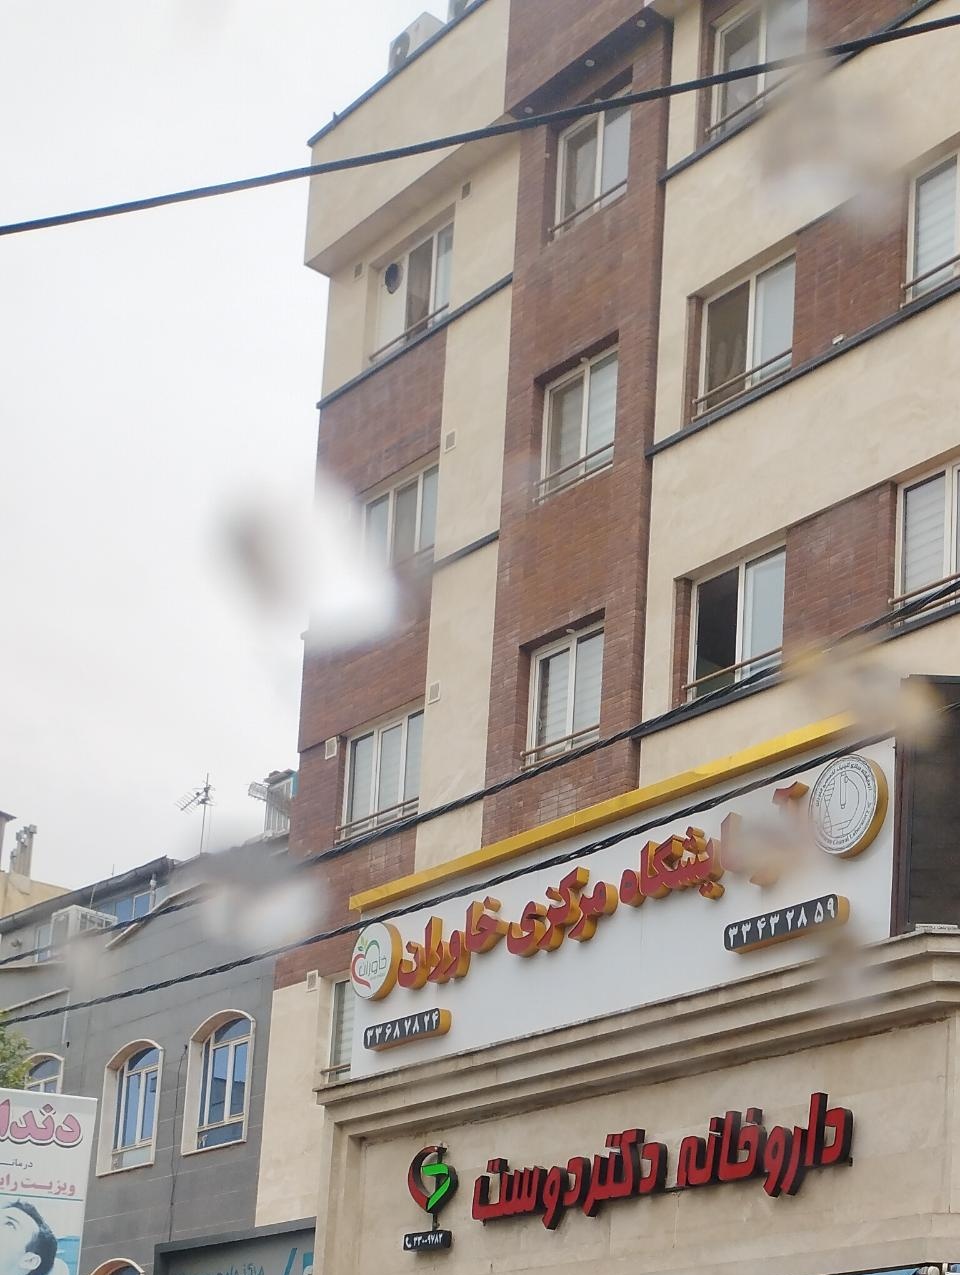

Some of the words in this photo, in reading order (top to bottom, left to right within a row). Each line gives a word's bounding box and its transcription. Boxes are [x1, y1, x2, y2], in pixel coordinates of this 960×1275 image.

[397, 896, 508, 990] خاوران
[507, 866, 618, 958] مرکزی
[21, 1178, 76, 1197] ویزیت
[583, 1127, 668, 1218] دکتر
[677, 1091, 855, 1198] داروخانه
[471, 1156, 590, 1231] دوست
